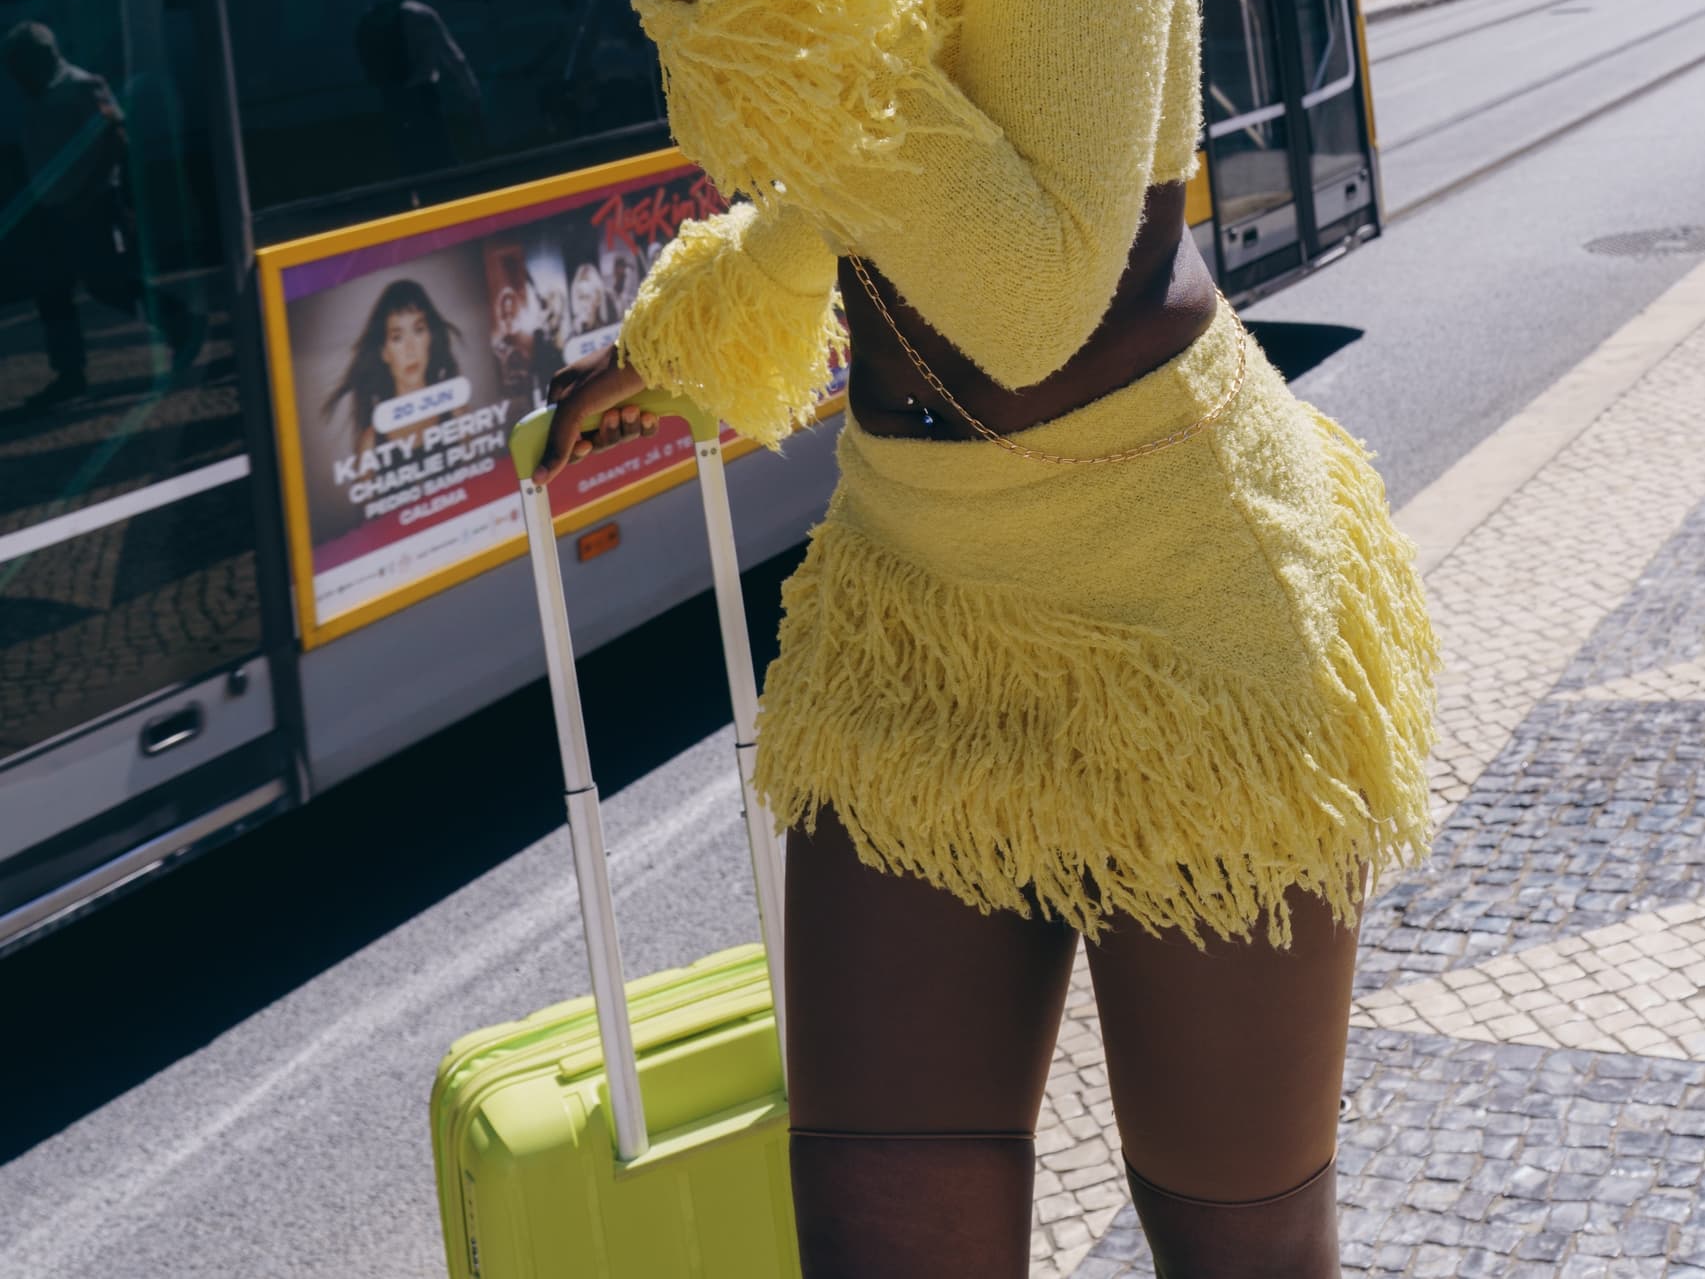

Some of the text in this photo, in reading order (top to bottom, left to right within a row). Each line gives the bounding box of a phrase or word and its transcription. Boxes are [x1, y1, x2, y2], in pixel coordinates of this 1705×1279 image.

[418, 388, 455, 411] JUN
[333, 433, 416, 485] KATY
[422, 399, 511, 452] PERRY
[349, 429, 506, 504] CHARLIE PUTH
[364, 456, 496, 519] PEDRO SAMPAIO
[398, 487, 469, 526] CALEMA
